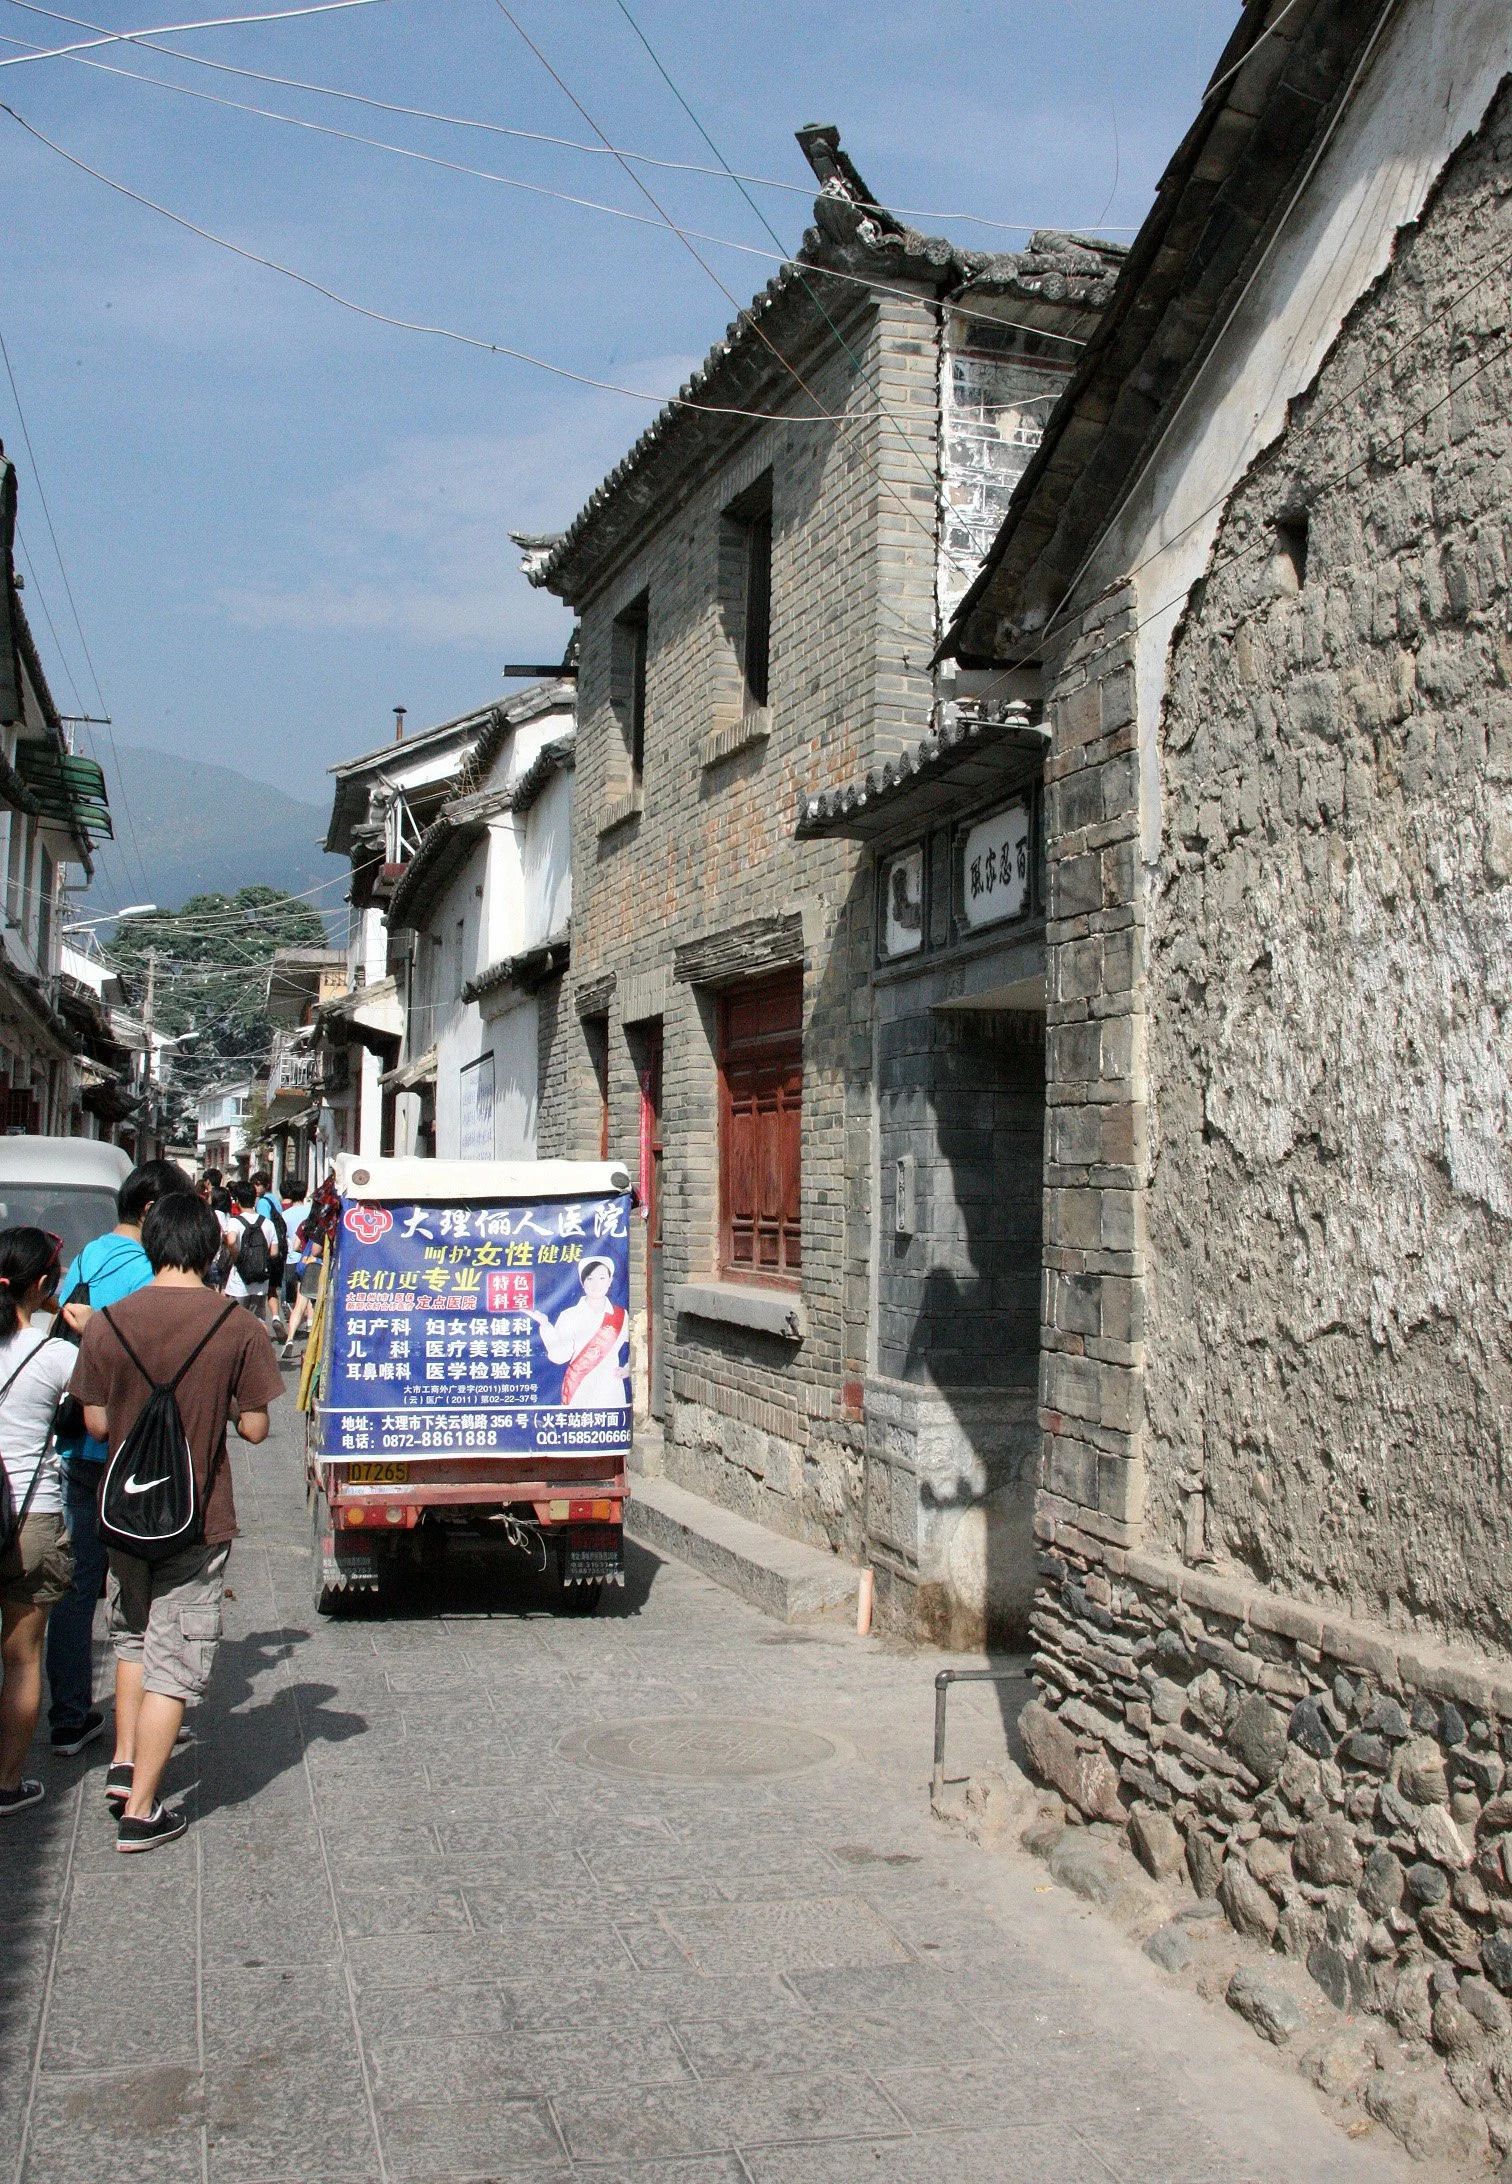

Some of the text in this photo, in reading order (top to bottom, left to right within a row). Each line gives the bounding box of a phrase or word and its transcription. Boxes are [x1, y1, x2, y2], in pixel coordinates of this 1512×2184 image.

[401, 1204, 628, 1239] 大理俪人医院
[423, 1241, 584, 1267] 呵护女性健康
[346, 1268, 484, 1293] 我们更专业
[492, 1274, 530, 1292] 特色
[416, 1295, 477, 1311] 定点医院
[492, 1292, 530, 1310] 科室
[346, 1317, 533, 1337] 妇产科 妇女保健科
[425, 1340, 533, 1358] 医疗美容科
[346, 1361, 533, 1381] 耳鼻喉科 医学检验科
